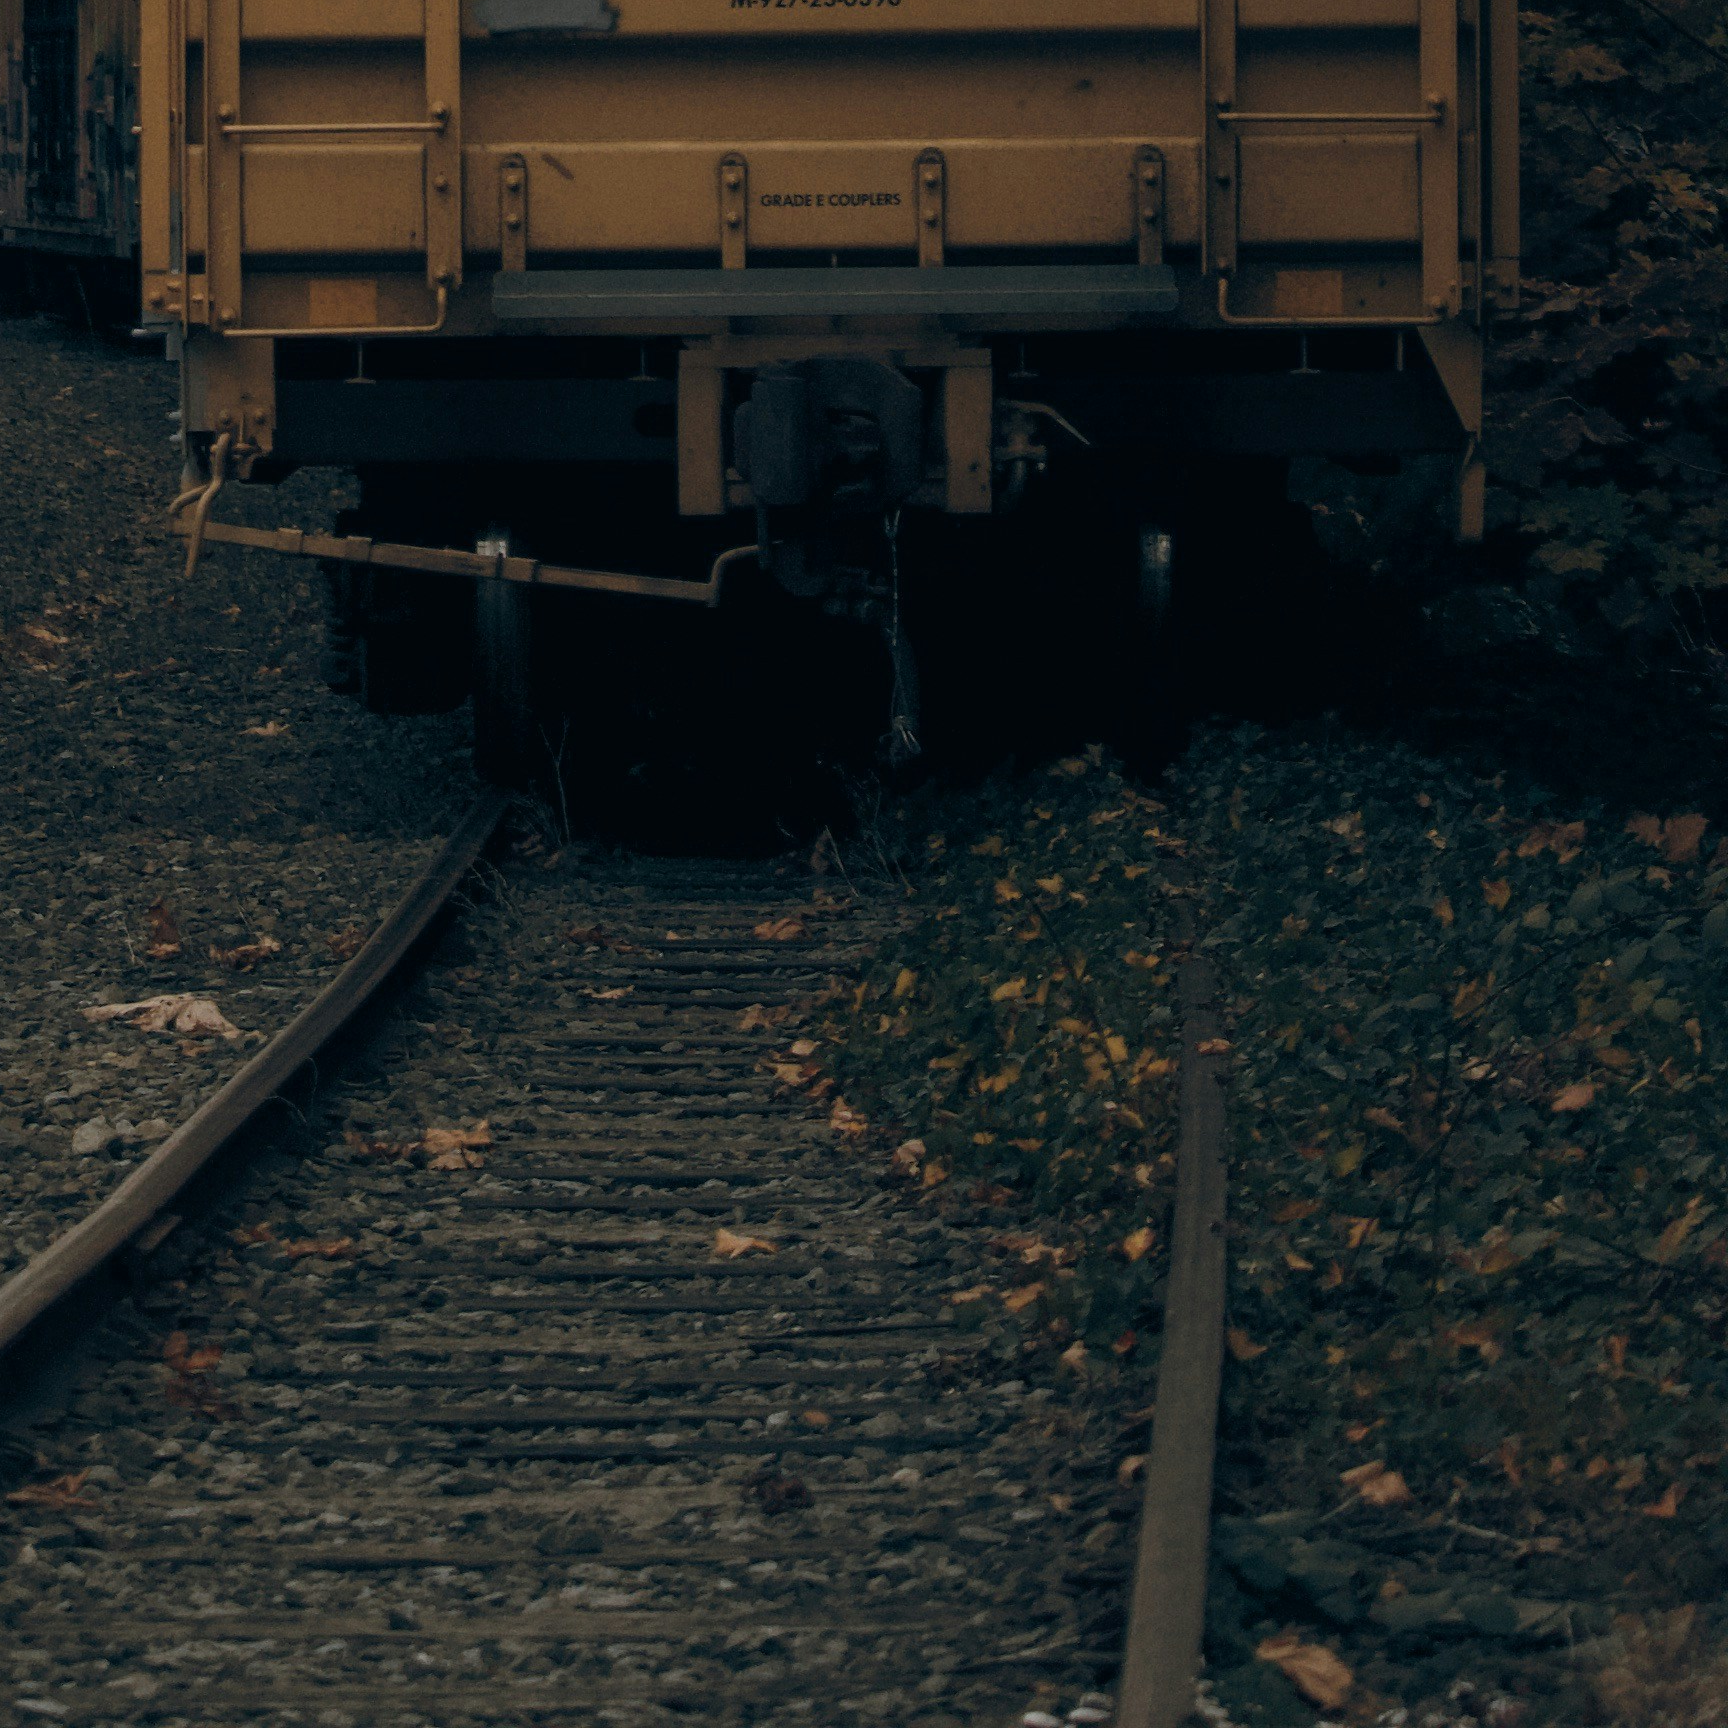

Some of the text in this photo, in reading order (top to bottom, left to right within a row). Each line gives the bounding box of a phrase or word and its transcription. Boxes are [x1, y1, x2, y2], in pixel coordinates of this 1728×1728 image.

[760, 192, 902, 207] GRADE E COUPLERS
